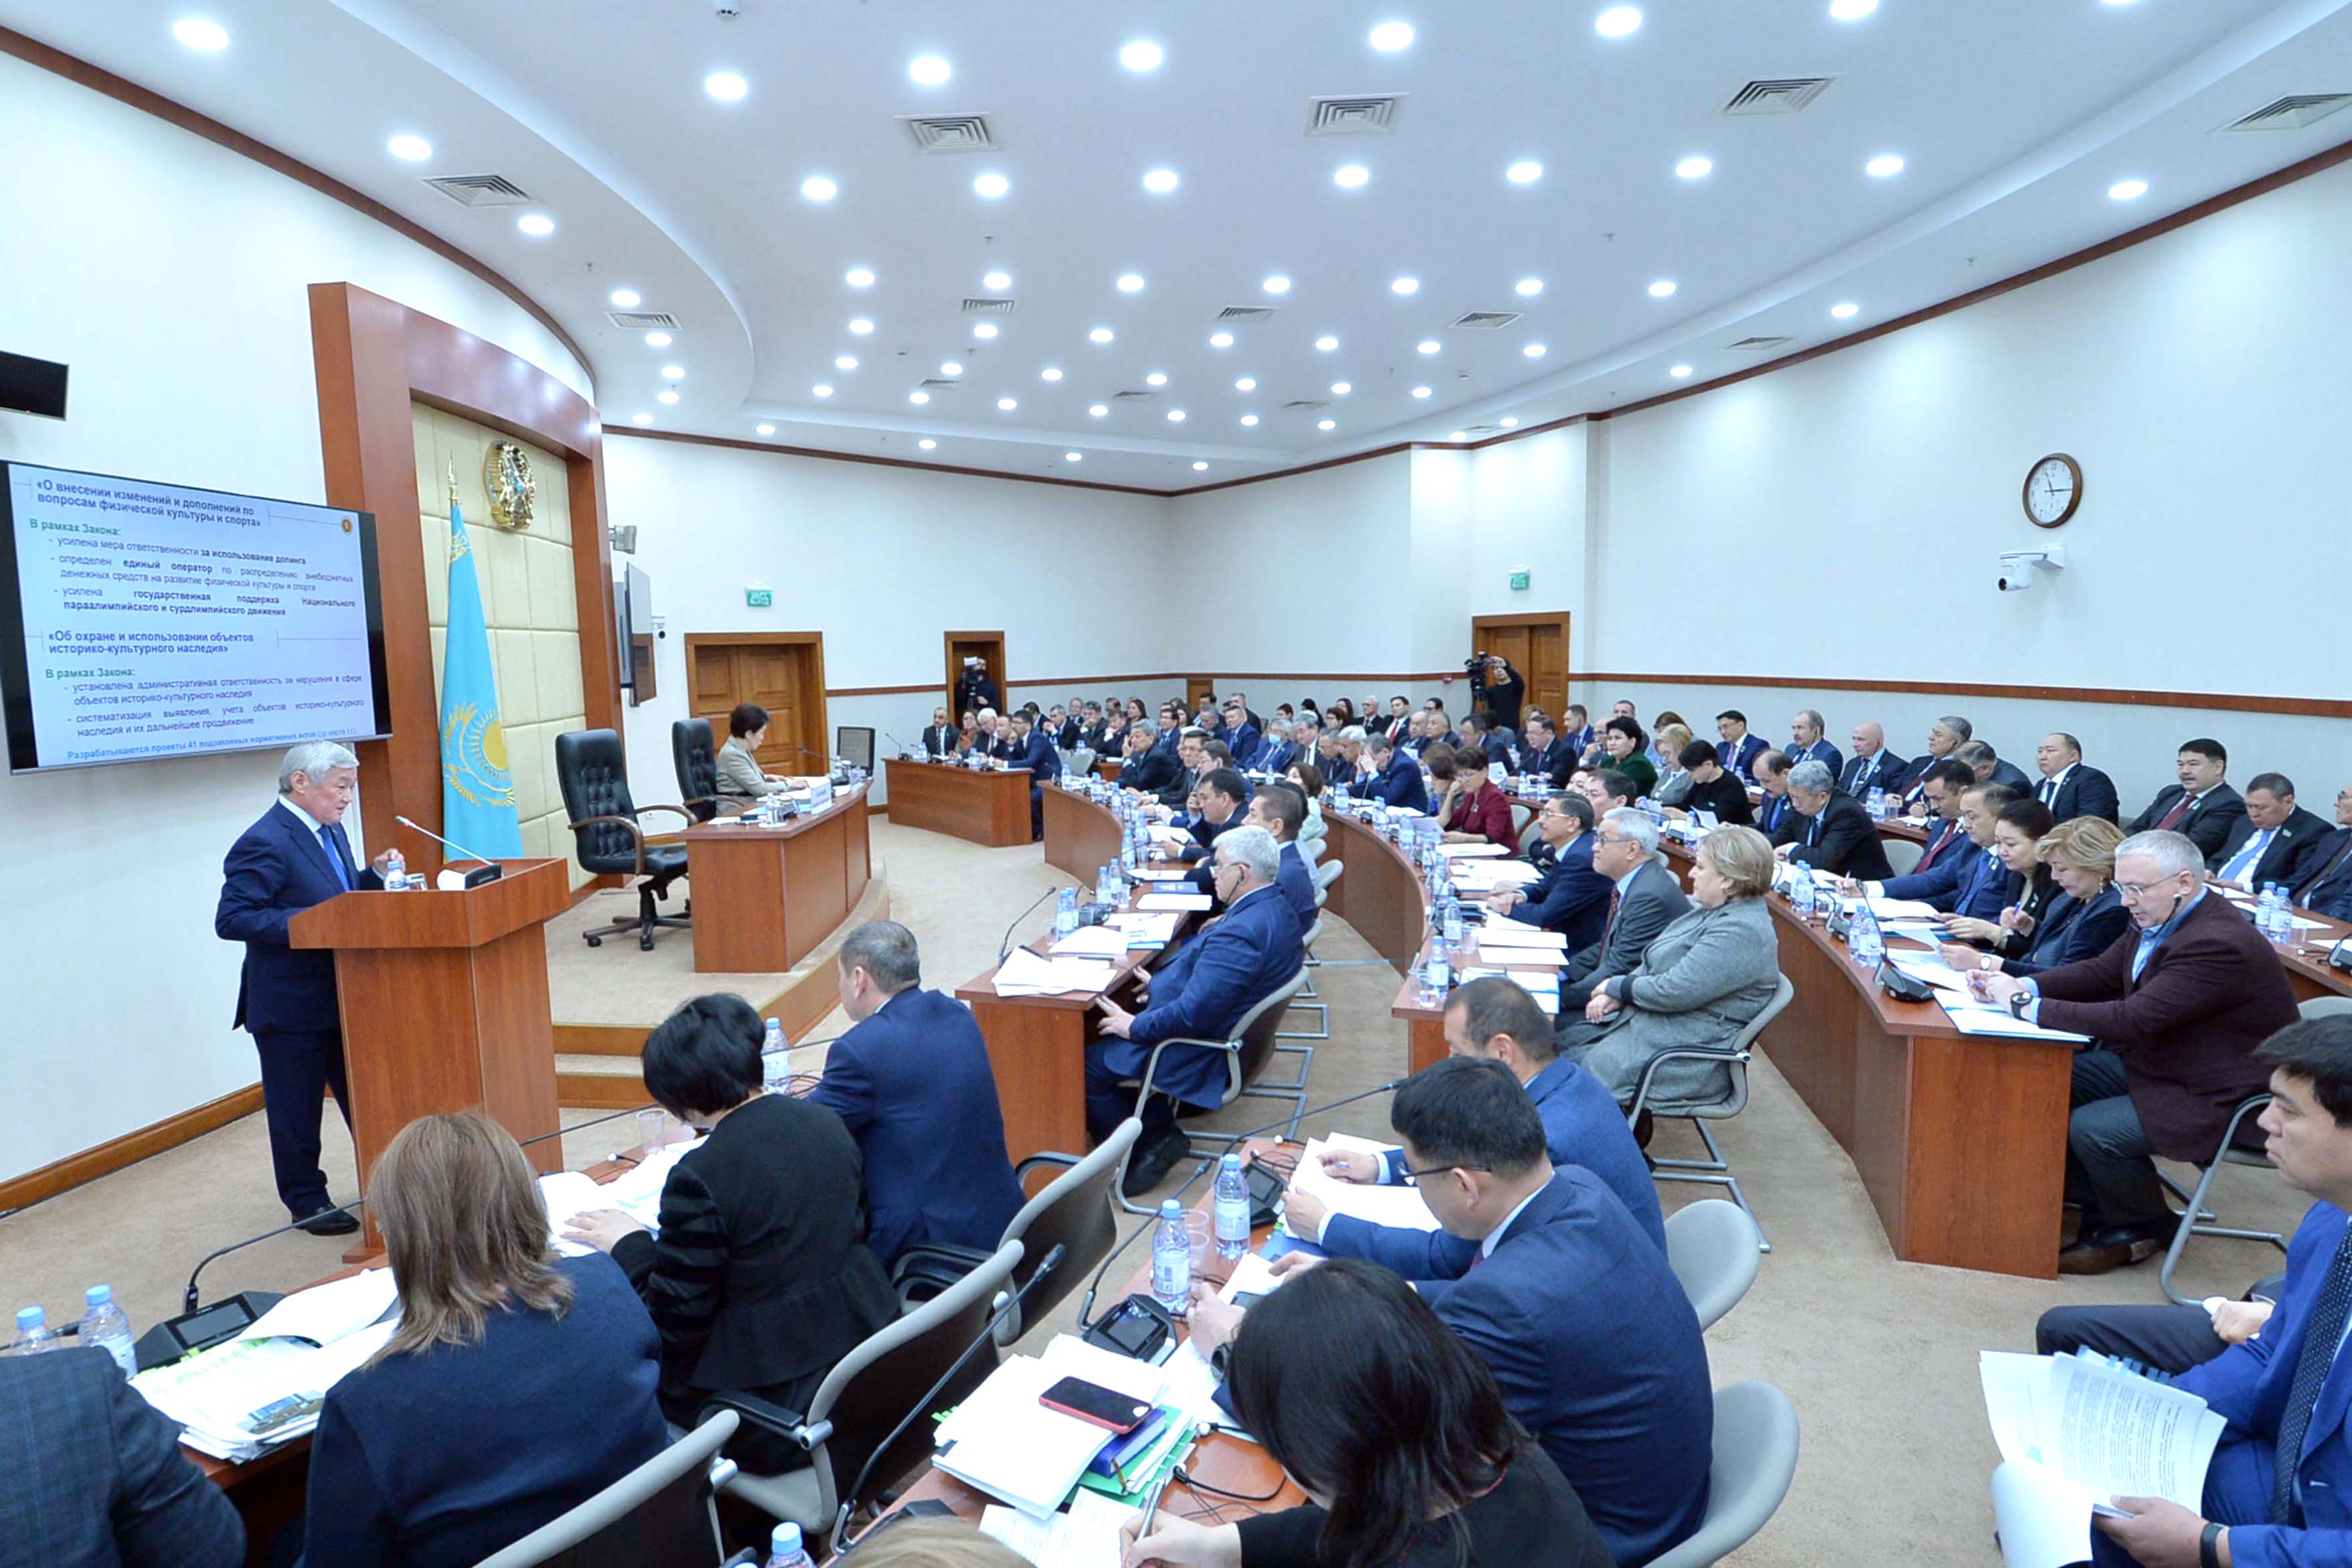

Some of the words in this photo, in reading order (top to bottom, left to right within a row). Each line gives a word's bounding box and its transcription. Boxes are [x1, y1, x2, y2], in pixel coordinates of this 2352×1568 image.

[37, 479, 52, 490] «О
[56, 483, 111, 497] внесении
[114, 490, 171, 505] изменений
[183, 499, 240, 514] дополнений
[243, 508, 254, 516] по
[38, 493, 96, 507] вопросам
[100, 499, 164, 516] физической
[167, 509, 214, 523] культуры
[225, 516, 260, 528] спорта»
[30, 518, 38, 528] В
[41, 520, 79, 532] рамках
[82, 523, 121, 535] Закона:
[57, 537, 98, 547] усилена
[100, 540, 124, 550] мера
[127, 542, 198, 556] ответственности
[212, 550, 274, 562] использование
[59, 554, 112, 566] определен
[123, 559, 161, 569] единый
[171, 562, 212, 574] оператор
[60, 569, 110, 580] денежных
[113, 571, 148, 582] средств
[164, 576, 202, 586] развитие
[62, 587, 103, 597] усилена
[133, 589, 211, 601] государственная
[236, 593, 279, 604] поддержка
[302, 597, 356, 607] Национального
[64, 601, 159, 611] параалимпийского
[48, 630, 72, 641] «Об
[76, 633, 116, 643] охране
[129, 633, 208, 642] использовании
[210, 632, 254, 643] объектов
[49, 643, 175, 656] историко-культурного
[177, 643, 228, 654] наследия»
[45, 669, 54, 678] В
[57, 669, 94, 680] рамках
[98, 668, 135, 677] Закона:
[73, 682, 133, 693] установлена
[137, 678, 217, 691] административная
[220, 676, 281, 686] ответственность
[74, 695, 119, 706] объектов
[121, 690, 214, 704] историко-культурного
[216, 689, 253, 699] наследия
[76, 711, 151, 724] систематизация
[222, 705, 244, 715] учета
[78, 726, 123, 737] наследия
[147, 721, 200, 732] дальнейшее
[202, 716, 255, 729] продвижение
[68, 745, 149, 760] Разрабатываются
[151, 742, 186, 753] проекты
